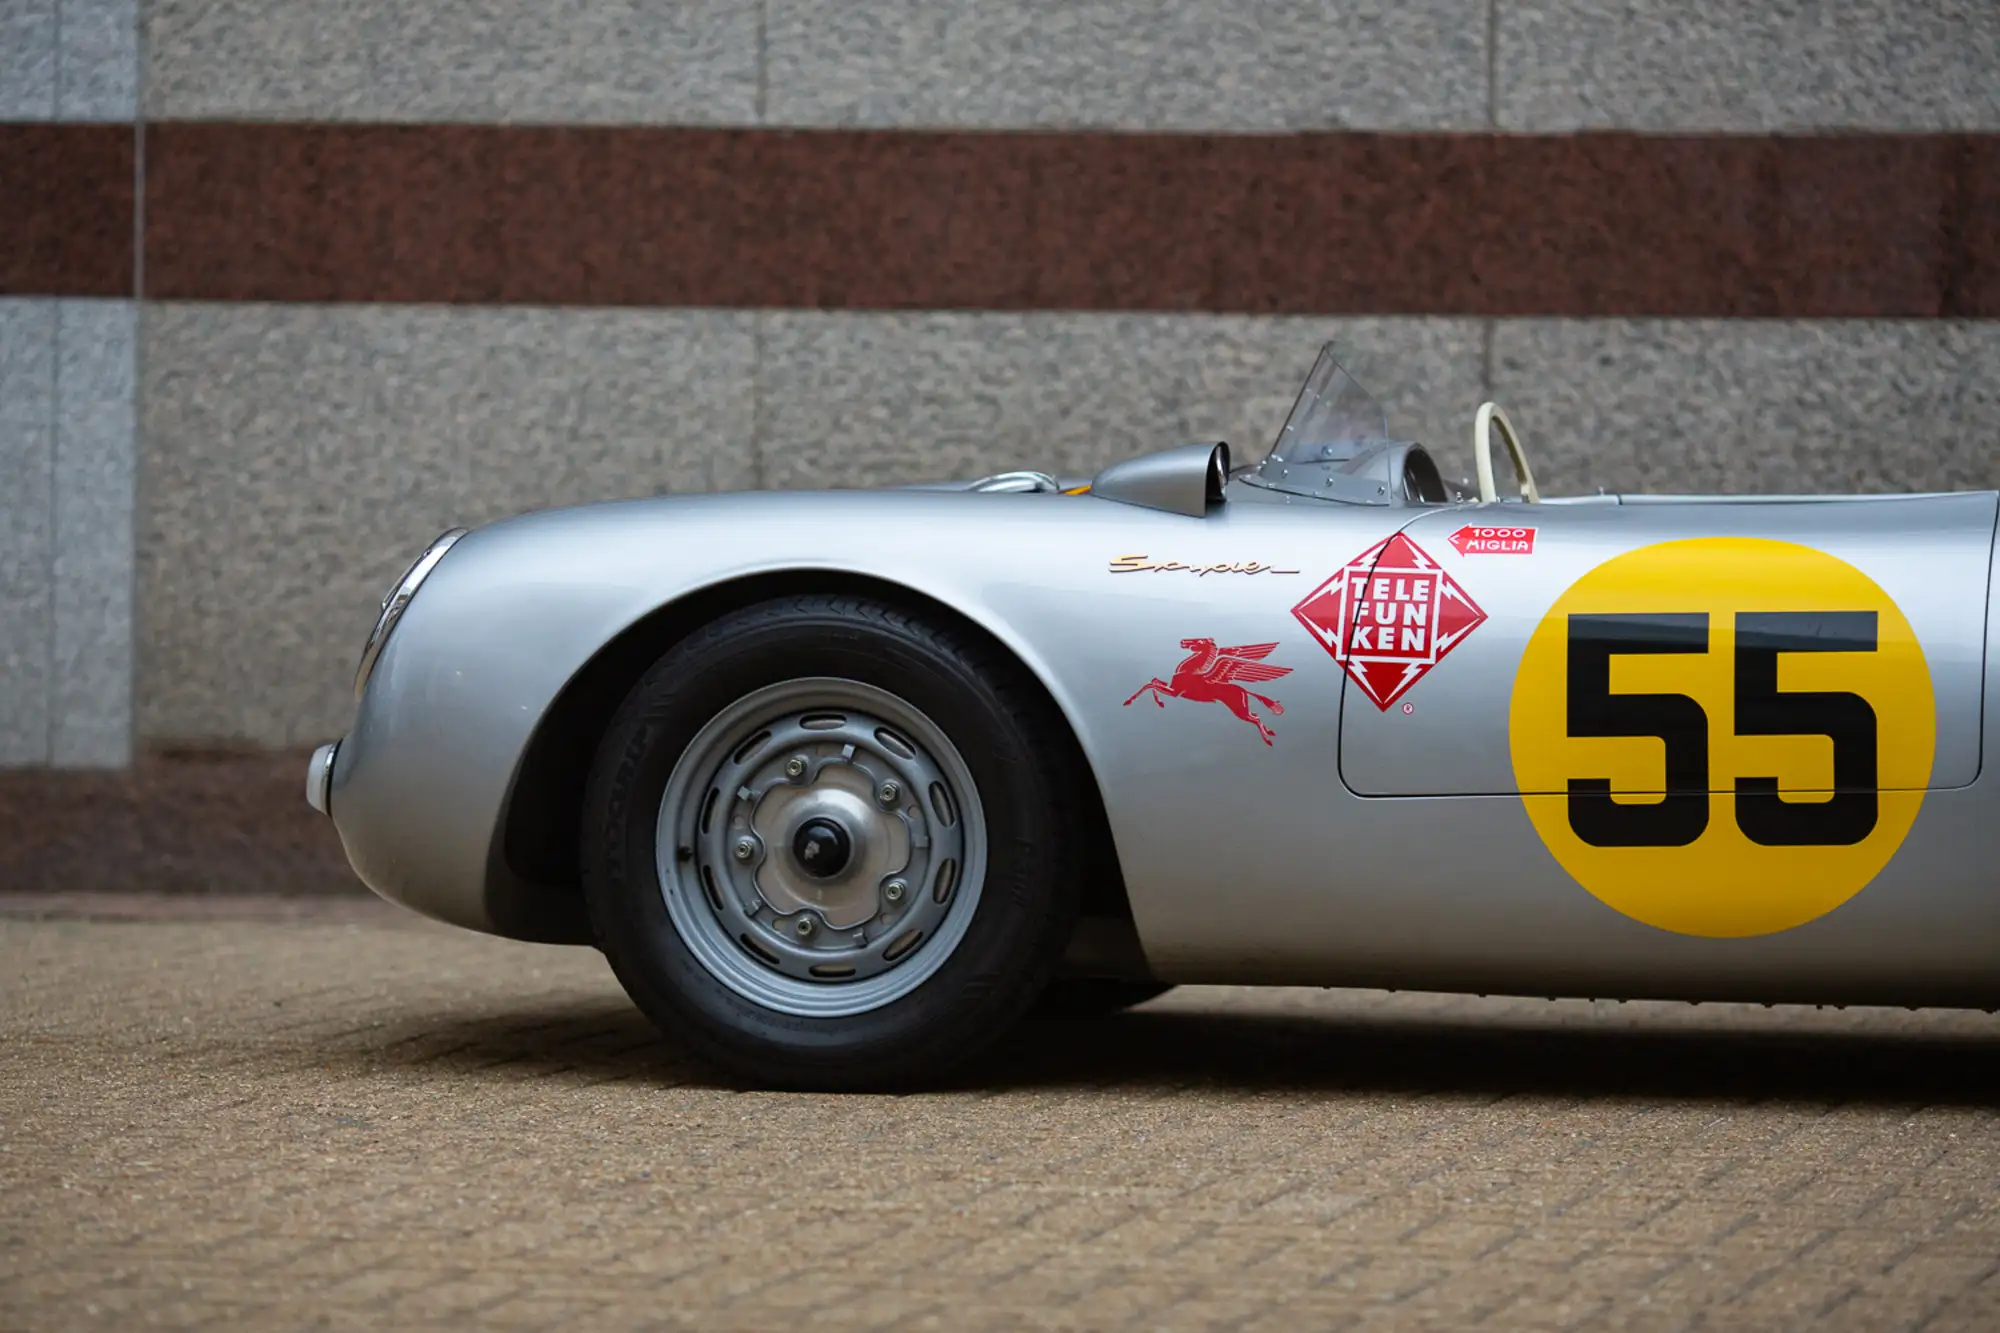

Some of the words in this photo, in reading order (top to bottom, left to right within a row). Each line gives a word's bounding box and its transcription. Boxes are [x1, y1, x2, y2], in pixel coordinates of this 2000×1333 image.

[1466, 540, 1529, 551] MIGLIA
[1472, 528, 1526, 538] 1000
[1351, 577, 1430, 602] TELE
[1352, 600, 1427, 626] FUN
[1351, 625, 1426, 651] KEN
[1566, 610, 1879, 847] 55
